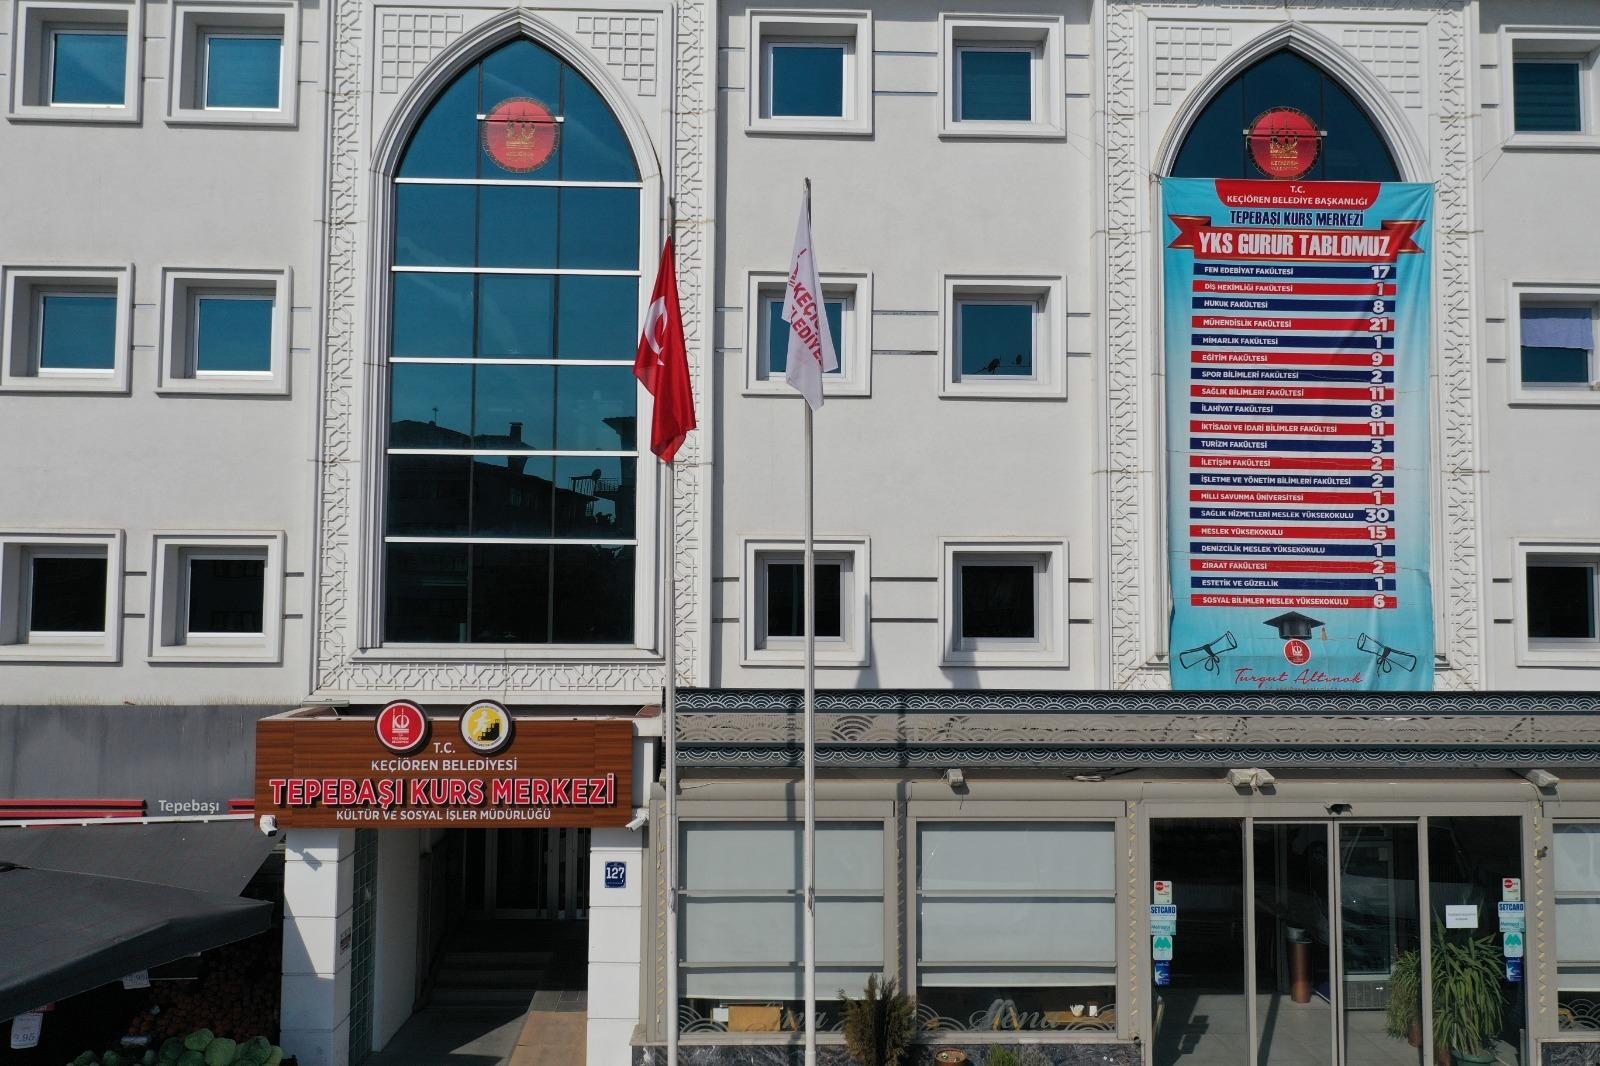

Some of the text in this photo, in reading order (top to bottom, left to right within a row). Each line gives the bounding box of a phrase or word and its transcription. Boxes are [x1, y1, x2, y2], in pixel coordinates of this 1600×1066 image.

[1290, 185, 1305, 193] T.C.
[1227, 195, 1368, 206] KEÇİÖREN BELEDİYE BAŞKANLIĞI
[1230, 210, 1364, 227] TEPEBAŞI KURS MERKEZİ
[1199, 232, 1391, 256] YKS GURUR TABLOMUZ
[1256, 267, 1294, 275] FAKÜLTESİ
[1371, 266, 1390, 279] 17
[1205, 283, 1216, 291] DİŞ
[1255, 284, 1293, 292] FAKÜLTESİ
[1377, 283, 1383, 296] 1
[1373, 300, 1384, 313] 8
[1203, 318, 1252, 326] MÜHENDİSLİK
[1369, 318, 1388, 331] 21
[1203, 335, 1382, 349] MİMARLIK FAKÜLTESİ 1
[1372, 352, 1383, 366] 9
[1371, 370, 1382, 383] 2
[1370, 387, 1384, 400] 11
[1202, 404, 1233, 412] İLAHİYAT
[1371, 404, 1382, 418] 8
[1369, 422, 1385, 435] 11
[1371, 440, 1382, 453] 3
[1201, 457, 1382, 470] İLETİŞİM FAKÜLTESİ 2
[1201, 475, 1230, 483] İŞLETME
[1243, 475, 1275, 484] YÖNETİM
[1372, 474, 1383, 487] 2
[1373, 491, 1381, 505] 1
[1365, 509, 1389, 522] 30
[1231, 528, 1283, 536] YÜKSEKOKULU
[1368, 526, 1386, 539] 15
[1273, 545, 1325, 553] YÜKSEKOKULU
[1374, 544, 1382, 557] 1
[1373, 561, 1384, 574] 2
[1375, 578, 1383, 590] 1
[1232, 596, 1264, 604] BİLİMLER
[1296, 597, 1348, 605] YÜKSEKOKULU
[1374, 595, 1384, 608] 6
[1235, 668, 1288, 688] Turgut
[434, 742, 456, 753] T.C.
[371, 757, 517, 772] KEÇİÖREN BELEDİYESİ
[269, 772, 615, 809] TEPEBAŞI KURS MERKEZİ
[158, 799, 220, 816] Tepebaşı
[336, 808, 551, 822] KÜLTÜR VE SOSYAL İŞLER MÜDÜRLÜĞÜ
[606, 867, 625, 879] 127
[1151, 906, 1176, 914] SETCARD
[1499, 903, 1524, 911] SETCARD
